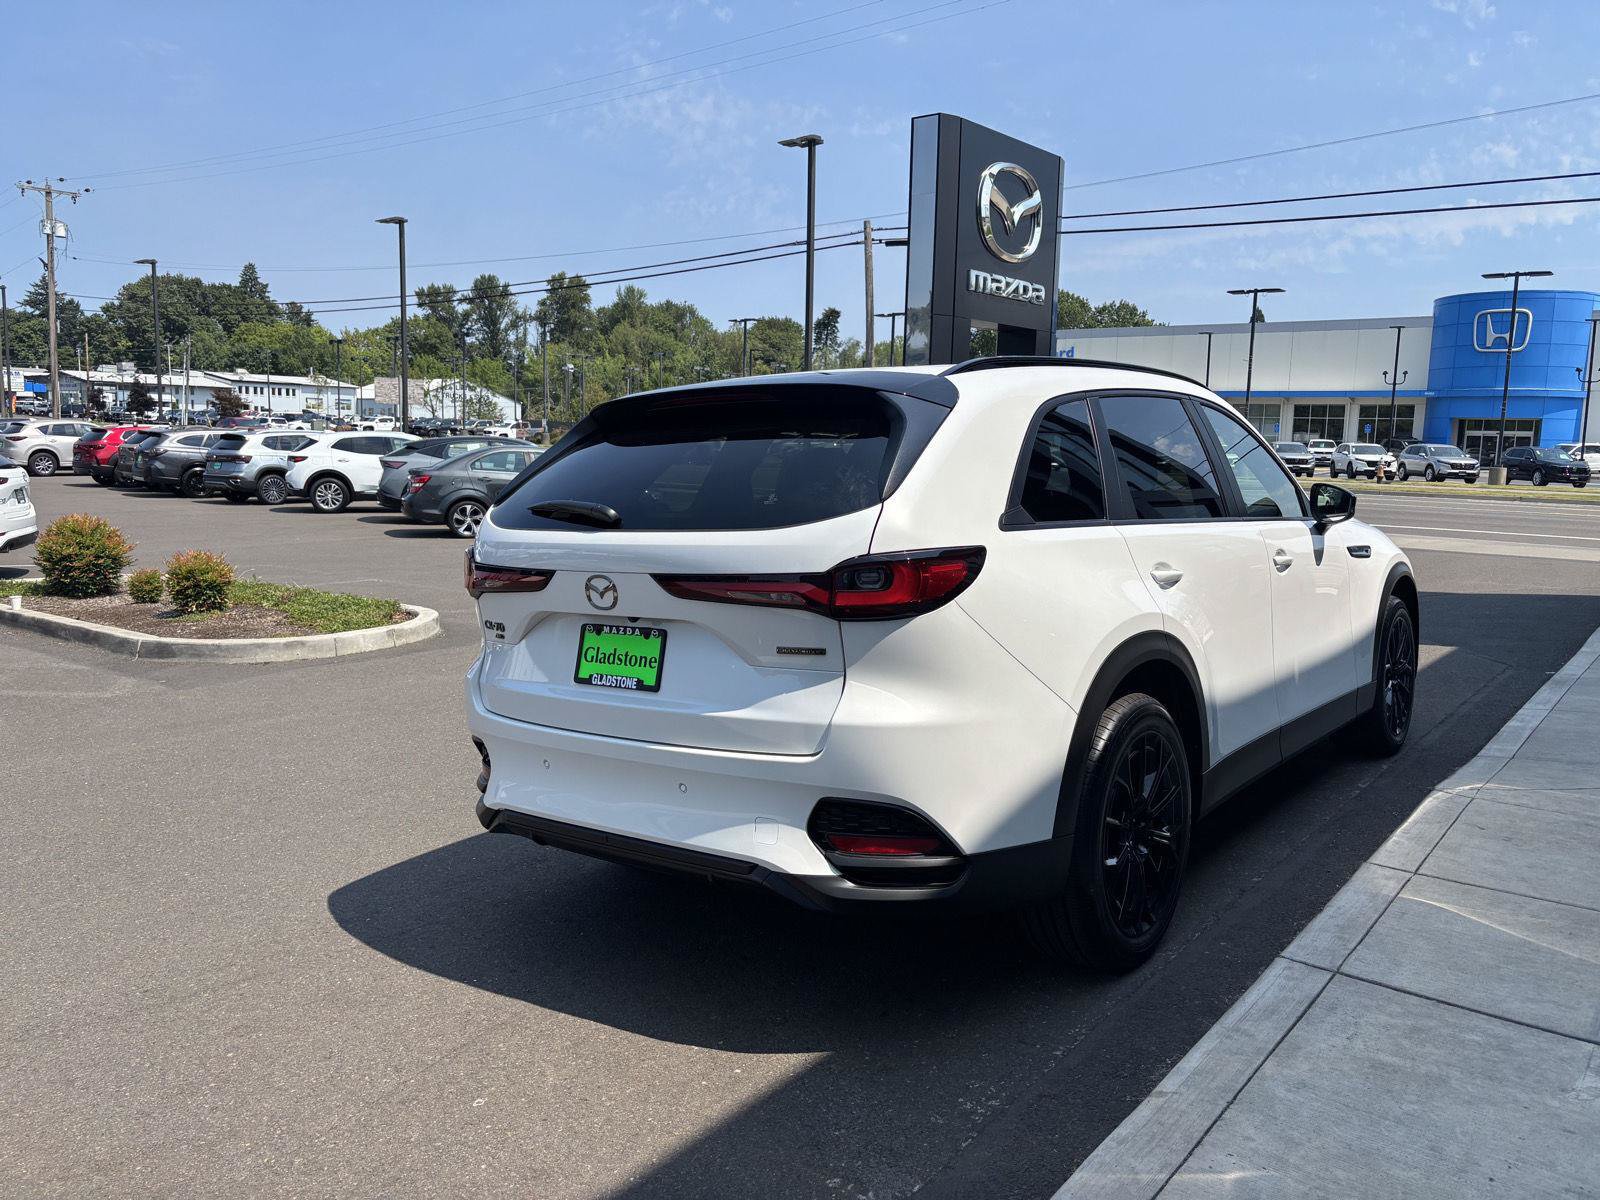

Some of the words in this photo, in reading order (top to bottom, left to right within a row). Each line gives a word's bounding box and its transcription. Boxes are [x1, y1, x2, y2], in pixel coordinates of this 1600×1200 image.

[602, 625, 641, 636] MAZDA
[583, 646, 658, 669] Gladstone
[591, 673, 638, 689] GLADSTONE
